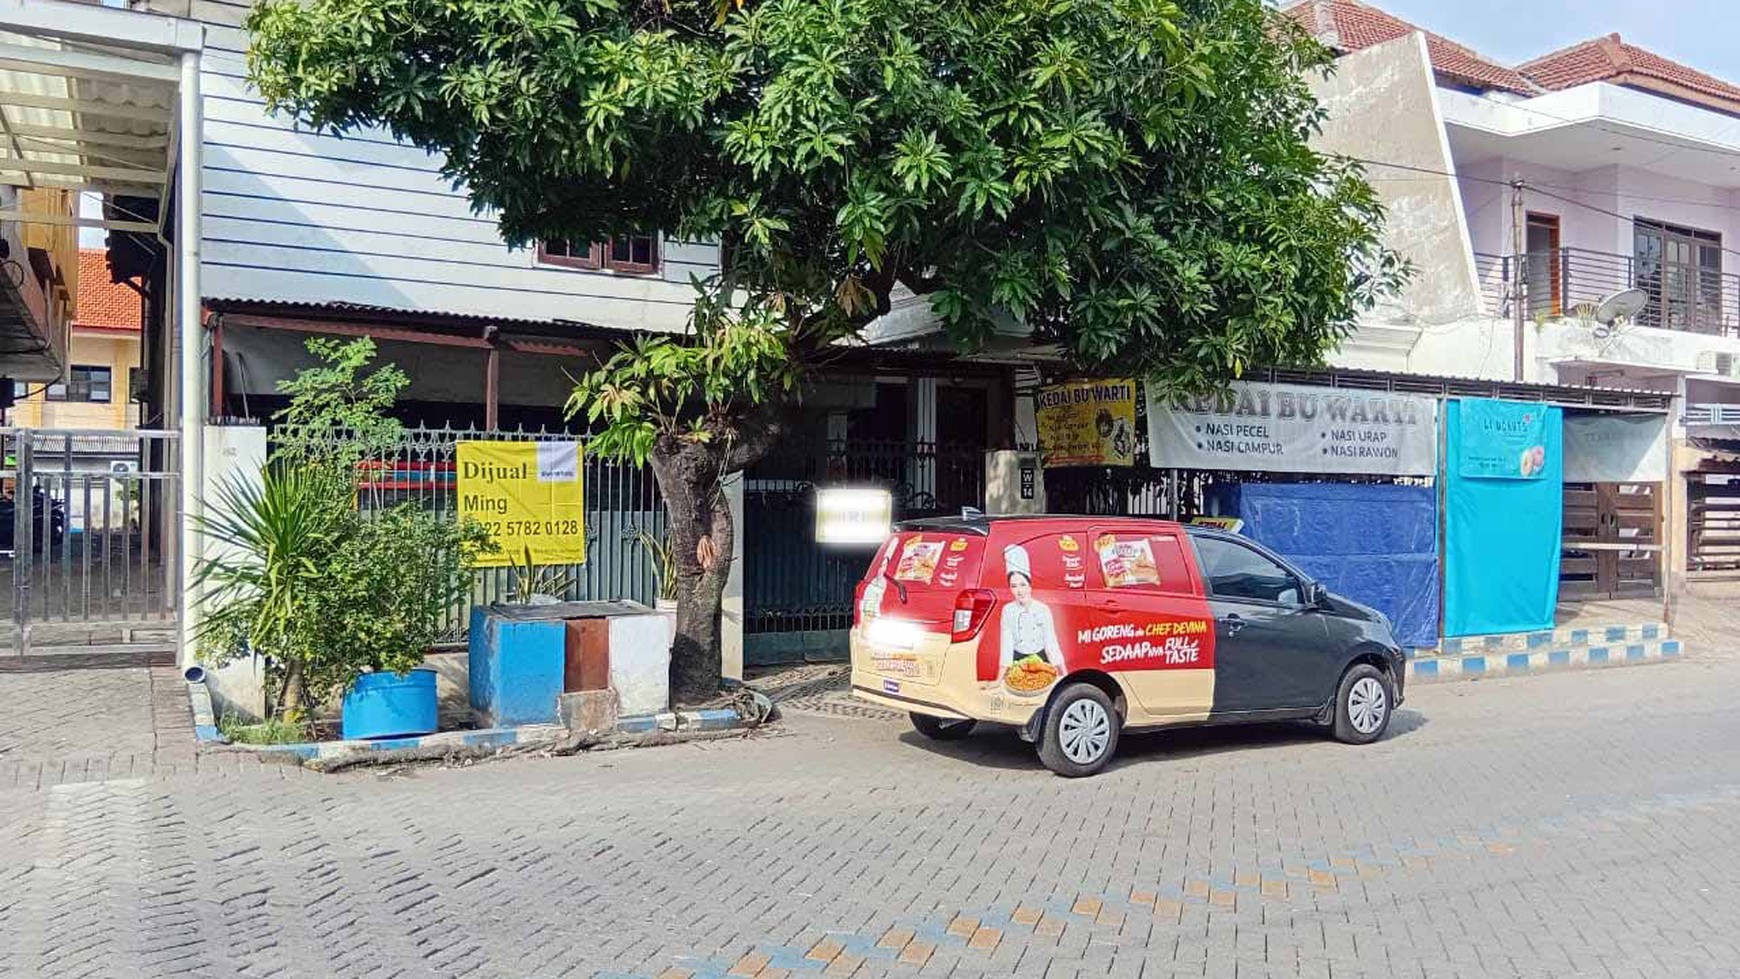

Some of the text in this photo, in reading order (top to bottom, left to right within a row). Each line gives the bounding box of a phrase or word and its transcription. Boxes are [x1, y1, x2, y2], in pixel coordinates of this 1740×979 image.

[1040, 384, 1131, 408] KEDAI BU WARTI
[1277, 391, 1318, 421] BU
[1205, 423, 1270, 438] NASI PECEL
[1331, 430, 1387, 443] NASI URAP
[1206, 441, 1284, 456] NASI CAMPUR
[1331, 446, 1398, 459] NASI RAWON
[463, 461, 527, 484] Dijual
[463, 494, 508, 515] Ming
[506, 521, 541, 536] 5782
[545, 520, 579, 535] 0128
[1077, 629, 1092, 644] MI
[1092, 624, 1135, 643] GORENG
[1145, 622, 1173, 637] CHEF
[1173, 620, 1207, 635] DEVINA
[1164, 636, 1190, 651] FULL
[1164, 648, 1201, 665] TASTE
